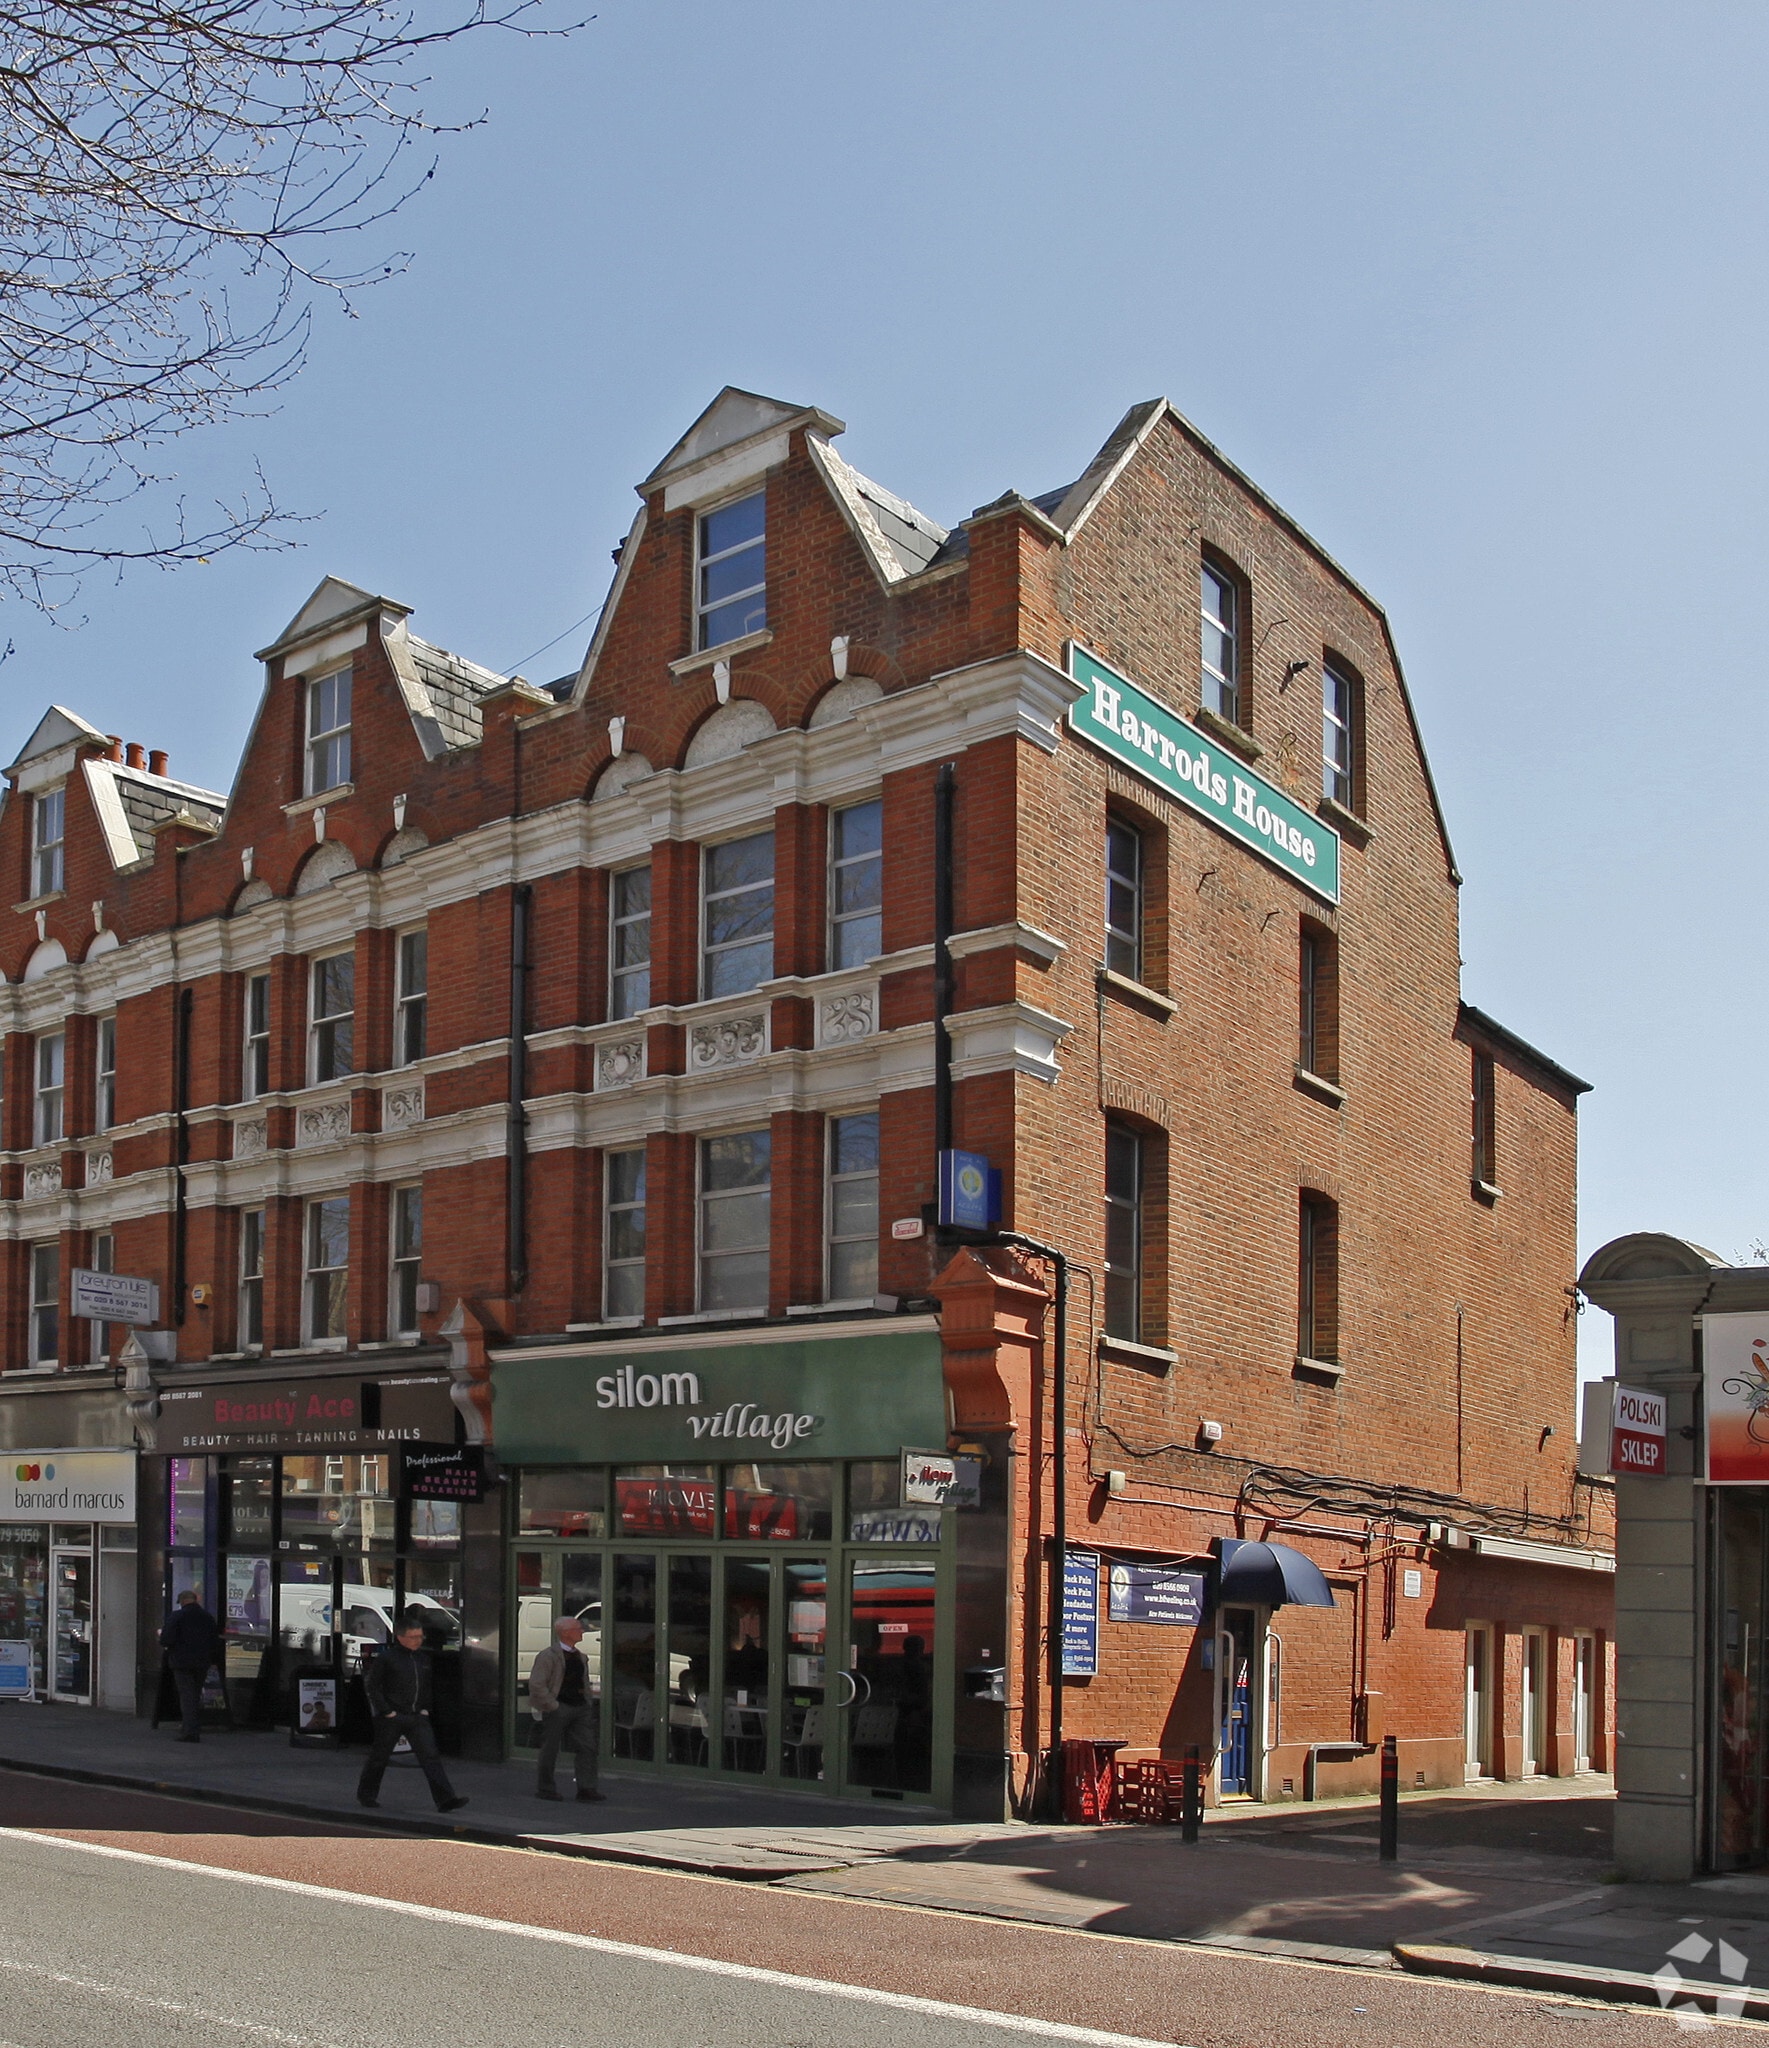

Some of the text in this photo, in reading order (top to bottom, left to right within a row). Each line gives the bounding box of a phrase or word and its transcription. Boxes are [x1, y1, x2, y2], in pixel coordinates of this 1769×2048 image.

[1091, 675, 1317, 868] Harrods House
[93, 1296, 109, 1304] 020
[214, 1393, 355, 1427] Beauty Ace
[596, 1366, 815, 1449] silom village
[1620, 1395, 1661, 1426] POLSKI
[182, 1435, 230, 1447] BEAUTY
[247, 1433, 278, 1444] HAIR
[296, 1430, 357, 1443] TANNING
[377, 1427, 421, 1441] NAILS
[405, 1450, 463, 1469] Professional
[1621, 1438, 1659, 1467] SKLEP
[424, 1476, 477, 1487] BEAUTY
[445, 1468, 477, 1477] HAIR
[15, 1487, 125, 1509] barnard marcus
[1079, 1575, 1092, 1585] Pain
[1079, 1588, 1092, 1597] Pain
[1072, 1625, 1088, 1634] more
